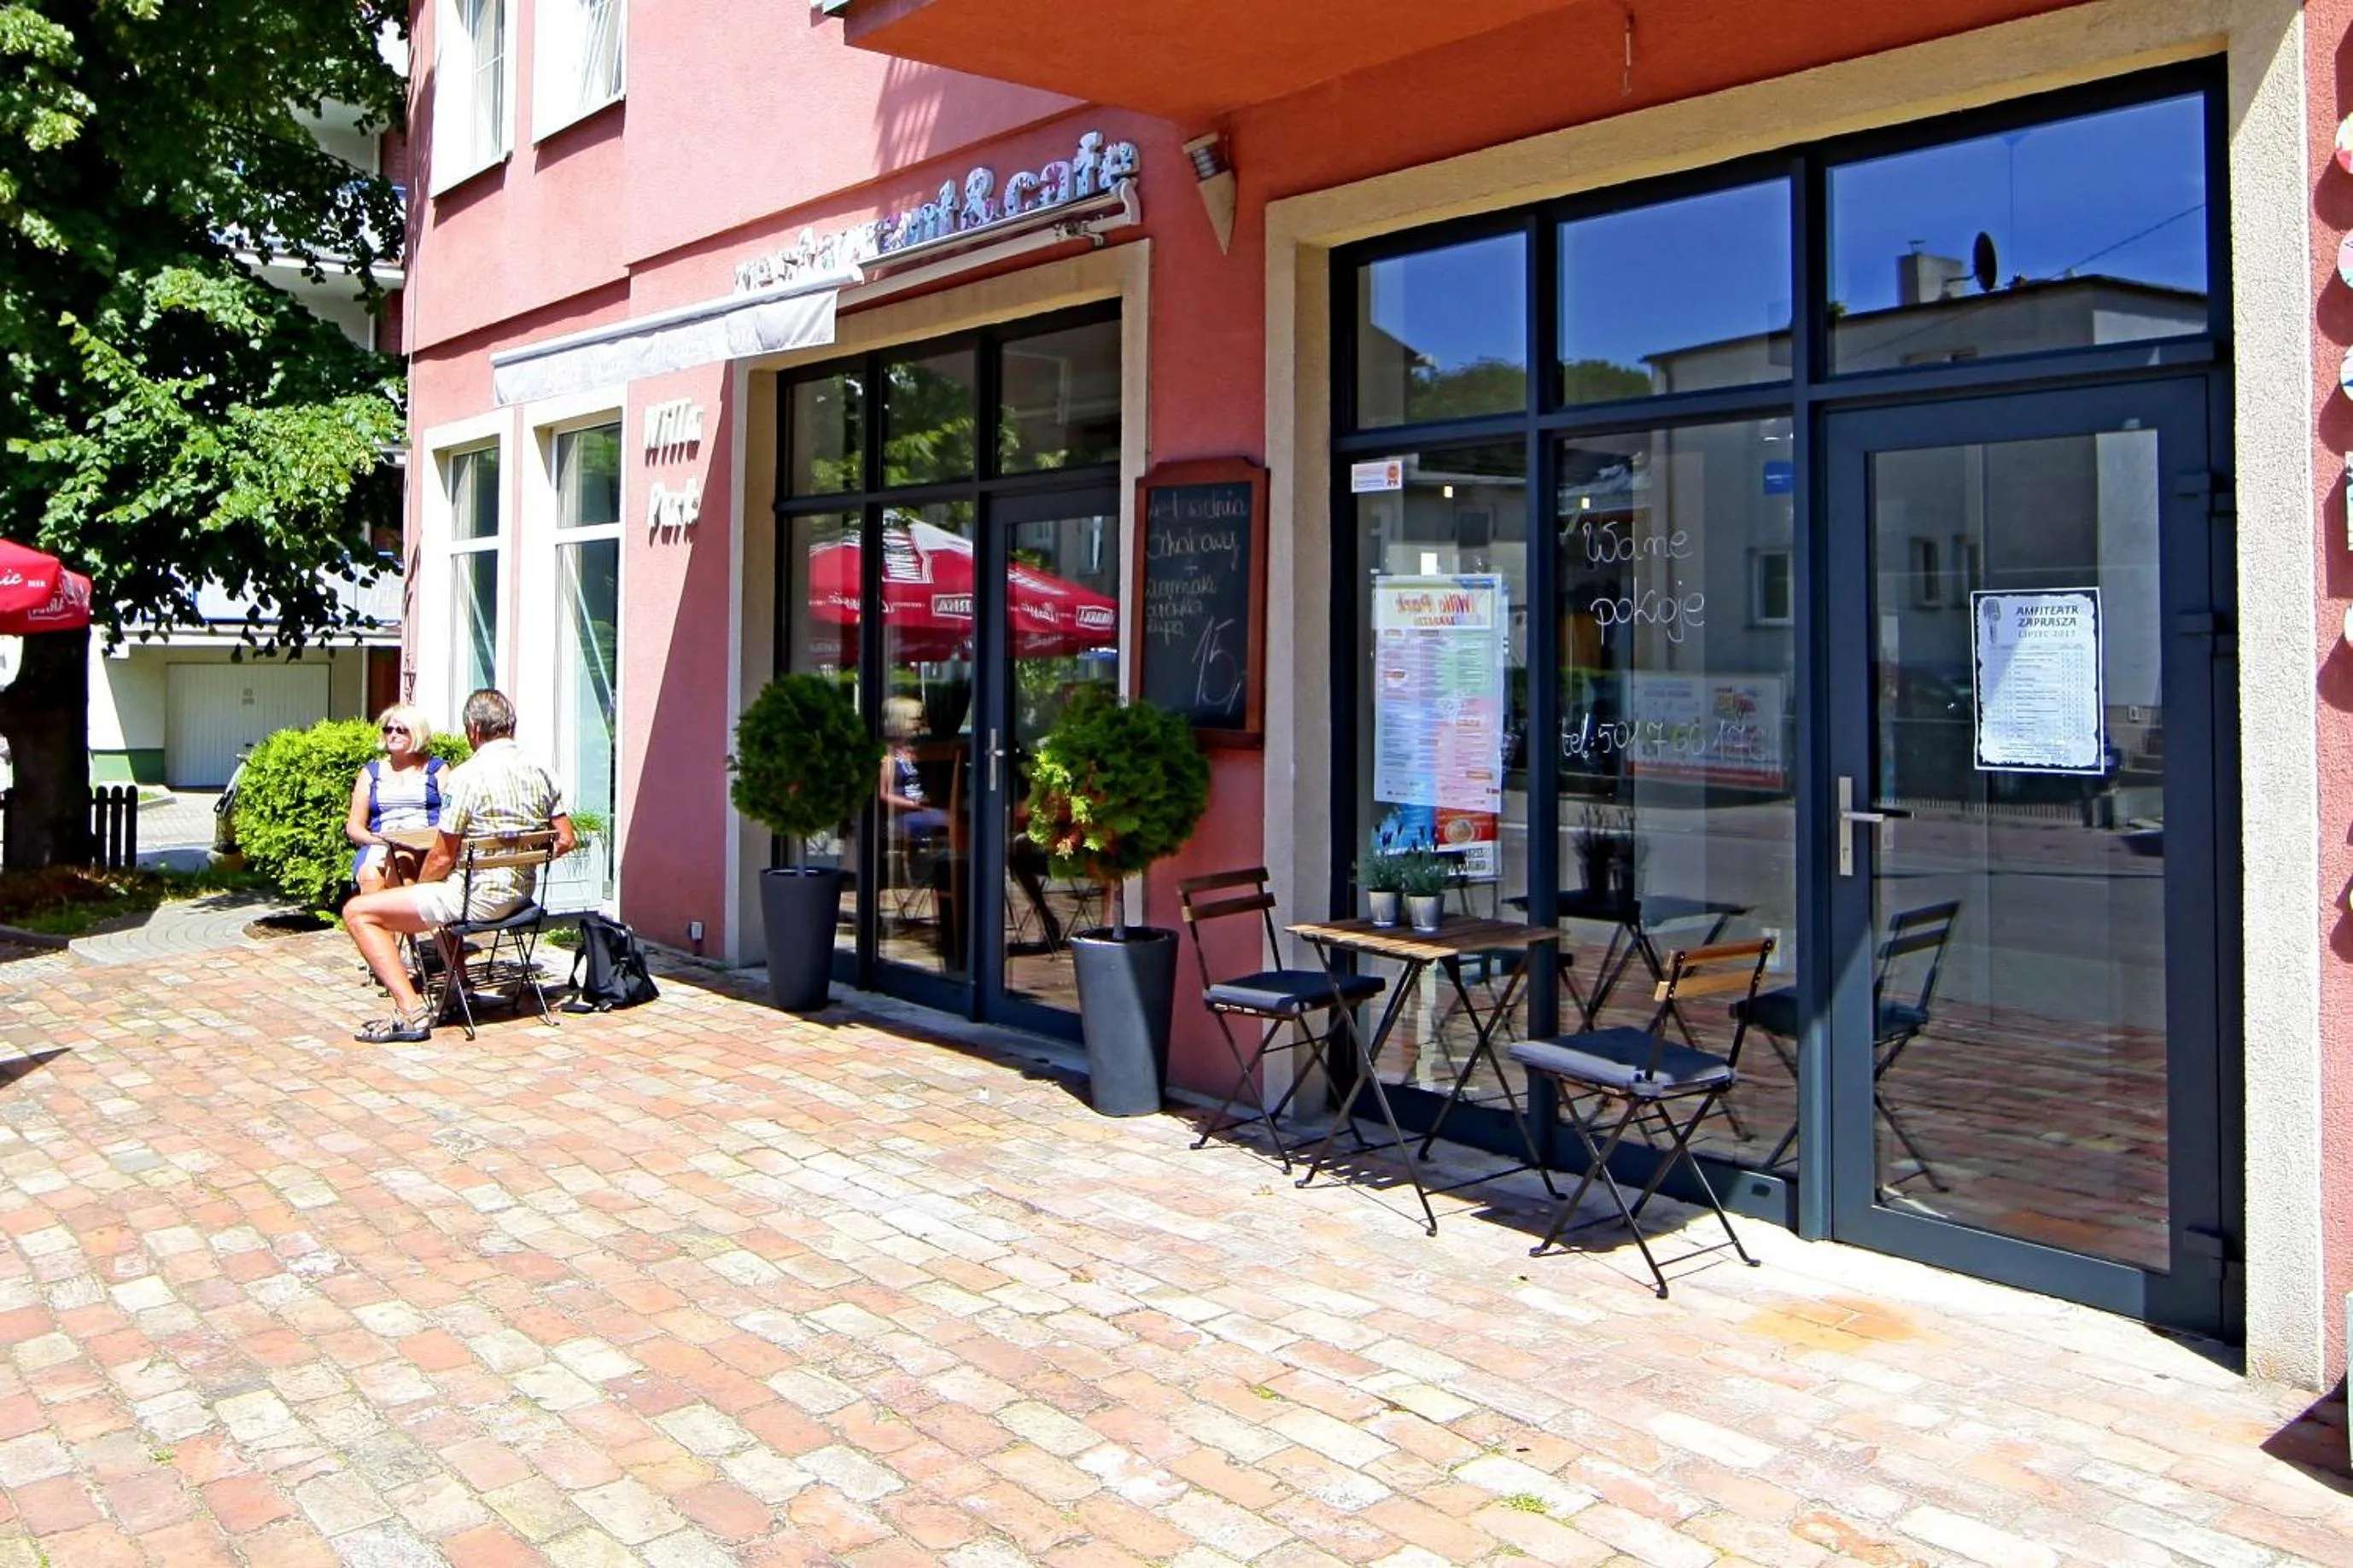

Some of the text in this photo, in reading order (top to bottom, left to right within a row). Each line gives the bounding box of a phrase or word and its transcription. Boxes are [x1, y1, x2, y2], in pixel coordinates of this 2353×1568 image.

[1004, 131, 1140, 217] cafe
[1590, 576, 1705, 646] pokoje
[2017, 617, 2077, 627] ZAPRASZA
